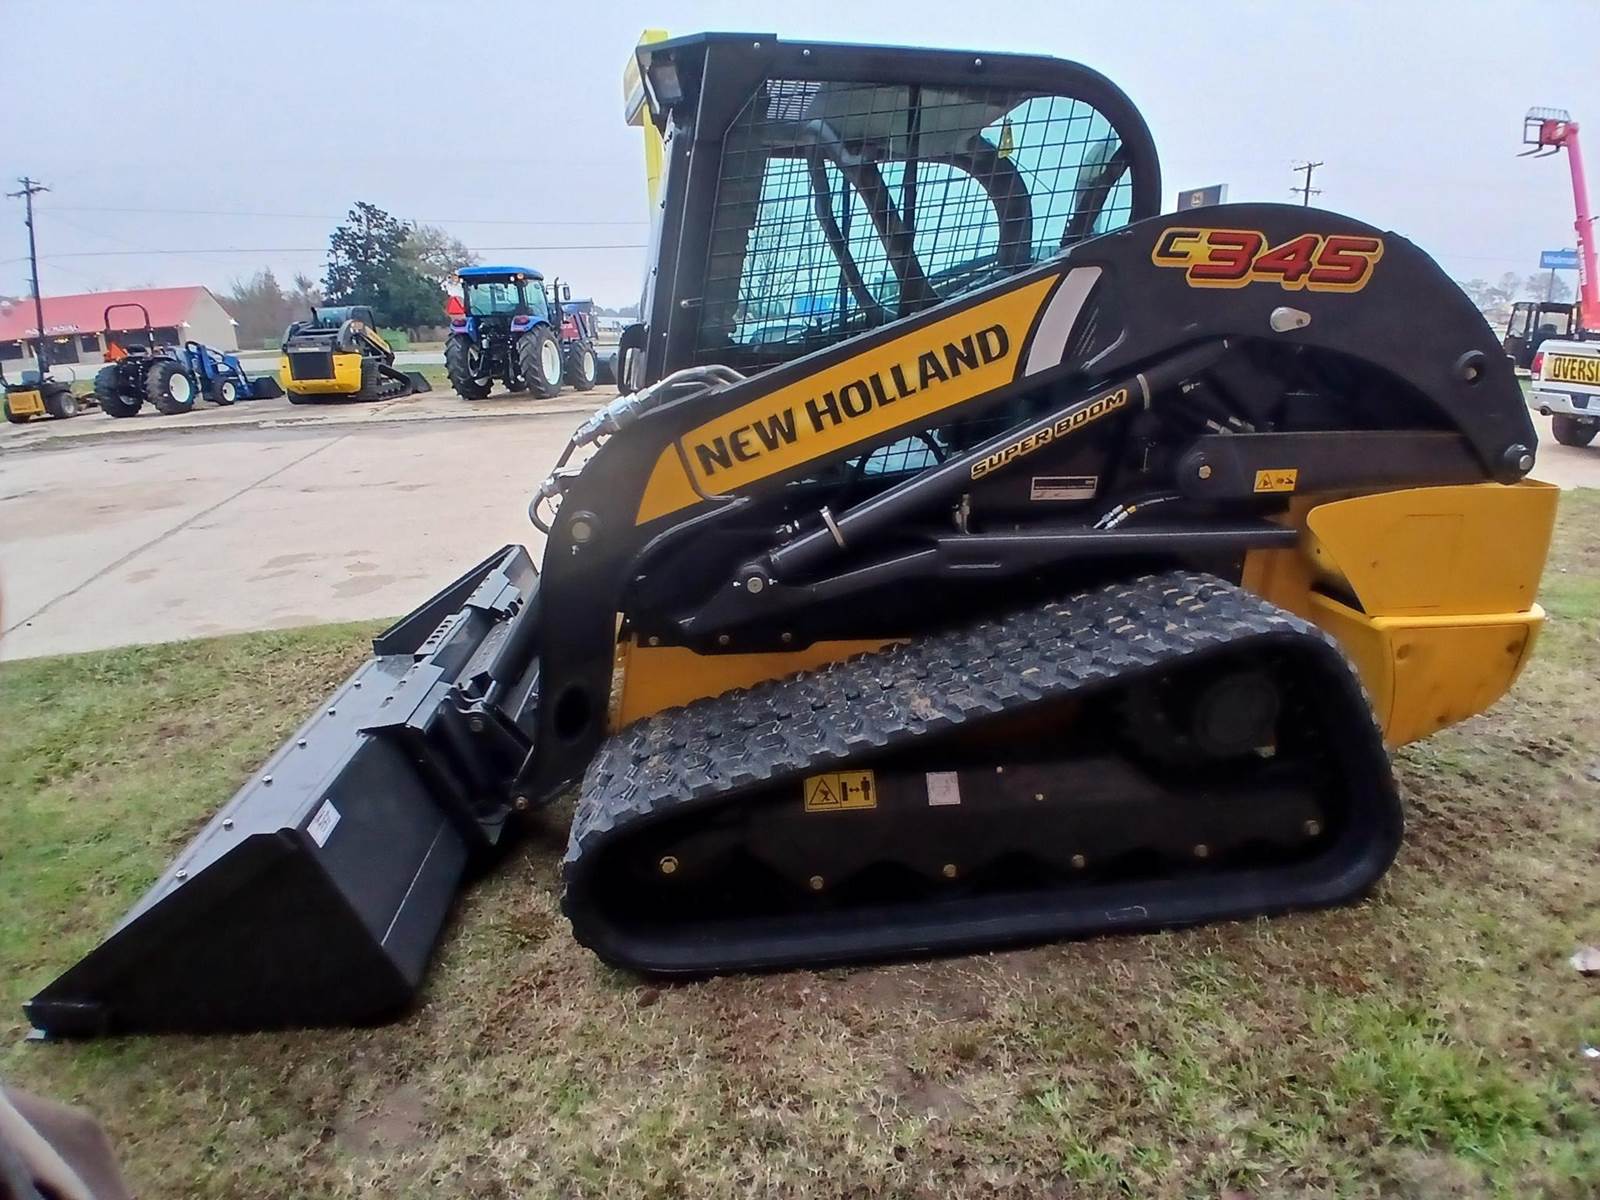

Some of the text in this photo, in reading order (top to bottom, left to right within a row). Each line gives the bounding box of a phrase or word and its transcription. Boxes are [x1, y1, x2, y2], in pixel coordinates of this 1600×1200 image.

[1153, 228, 1383, 291] C345
[695, 324, 1010, 476] NEW HOLLAND
[971, 389, 1128, 480] SUPER BOOM
